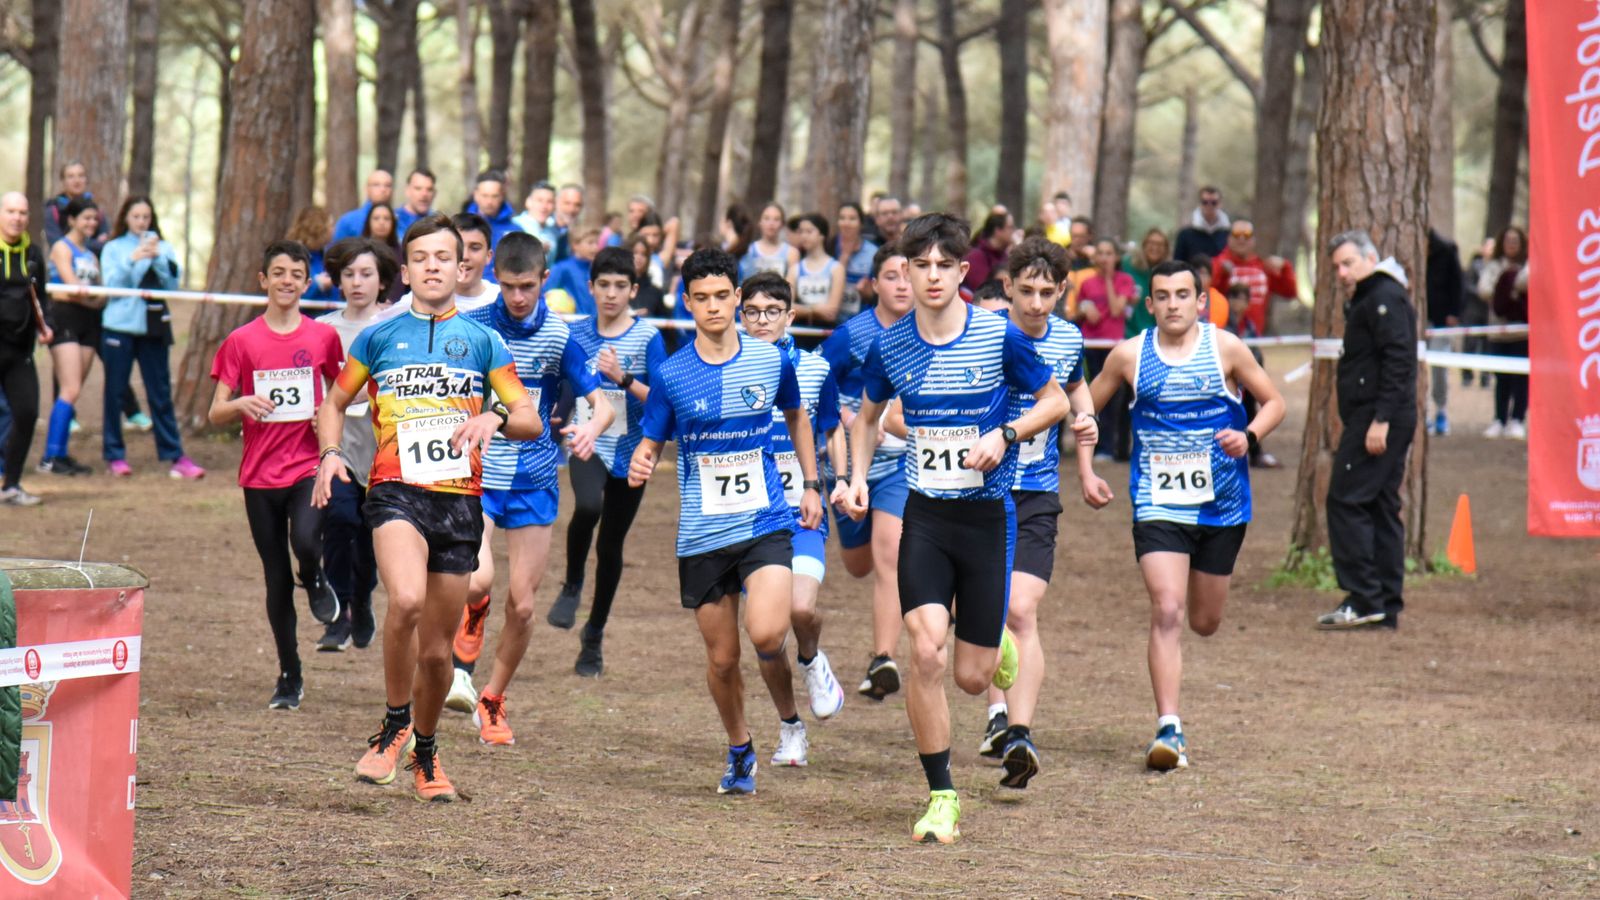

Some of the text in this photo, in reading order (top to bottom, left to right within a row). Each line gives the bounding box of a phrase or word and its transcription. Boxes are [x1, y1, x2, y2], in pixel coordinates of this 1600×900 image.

[405, 366, 444, 381] TRAIL
[270, 386, 301, 407] 63
[396, 383, 435, 397] TEAM
[407, 439, 463, 464] 168
[715, 473, 750, 496] 75
[1157, 470, 1207, 490] 216
